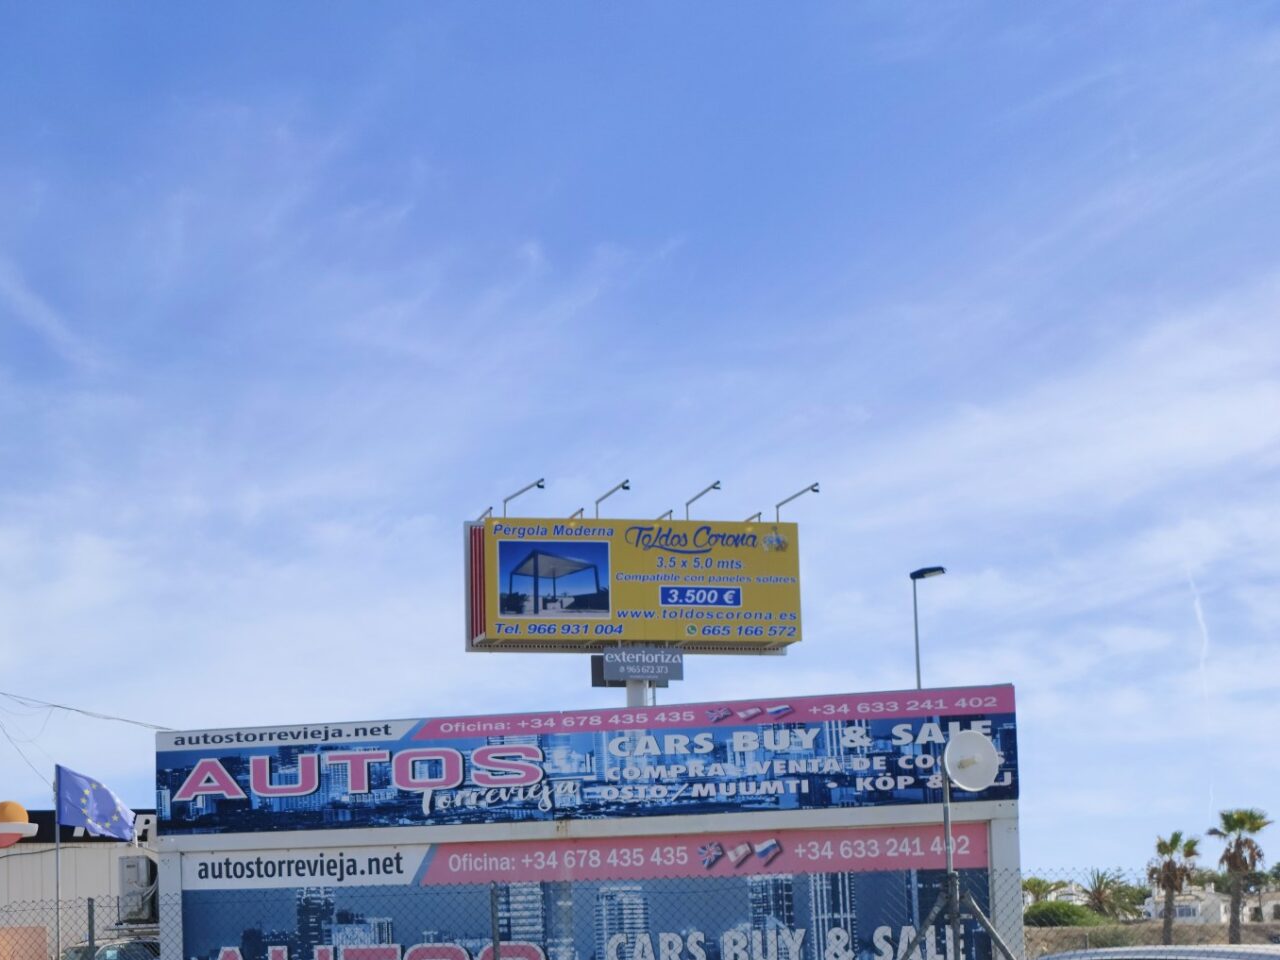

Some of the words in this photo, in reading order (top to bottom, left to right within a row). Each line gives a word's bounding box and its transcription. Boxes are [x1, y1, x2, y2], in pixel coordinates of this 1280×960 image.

[553, 525, 614, 536] Moderna
[625, 525, 688, 549] Toldos
[693, 526, 758, 549] Corona
[681, 560, 687, 569] x
[717, 559, 742, 569] mts
[615, 572, 680, 583] Compatible
[708, 575, 752, 584] paneles
[755, 575, 796, 583] solares
[668, 589, 718, 604] 3.500
[723, 590, 736, 604] €
[617, 609, 797, 620] www.toldoscorona.es
[495, 623, 521, 635] Tel.
[527, 624, 557, 634] 966
[561, 624, 589, 634] 931
[594, 624, 623, 634] 004
[702, 625, 730, 636] 665
[737, 625, 763, 636] 166
[768, 626, 797, 637] 572
[605, 651, 681, 663] exterioriza
[174, 724, 392, 747] autostorrevieja.net
[440, 720, 511, 734] Oficina:
[517, 718, 555, 729] +34
[562, 716, 602, 727] 678
[609, 713, 648, 724] 435
[655, 711, 695, 722] 435
[809, 704, 850, 715] +34
[857, 701, 898, 713] 633
[907, 699, 948, 711] 241
[955, 697, 997, 708] 402
[608, 732, 714, 757] CARS
[733, 727, 820, 752] BUY
[841, 726, 872, 748] &
[172, 744, 544, 802] AUTOS
[606, 764, 726, 781] COMPRA
[749, 757, 843, 775] VENTA
[853, 756, 886, 771] DE
[600, 779, 809, 801] OSTO/MUUMTI
[856, 772, 915, 792] KÖP
[419, 779, 581, 816] Torrevieja
[198, 852, 403, 881] autostorrevieja.net
[448, 854, 515, 873] Oficina:
[521, 852, 557, 869] +34
[563, 850, 601, 868] 678
[607, 848, 644, 866] 435
[650, 847, 688, 865] 435
[794, 841, 834, 860] +34
[839, 839, 880, 859] 633
[886, 837, 924, 857] 241
